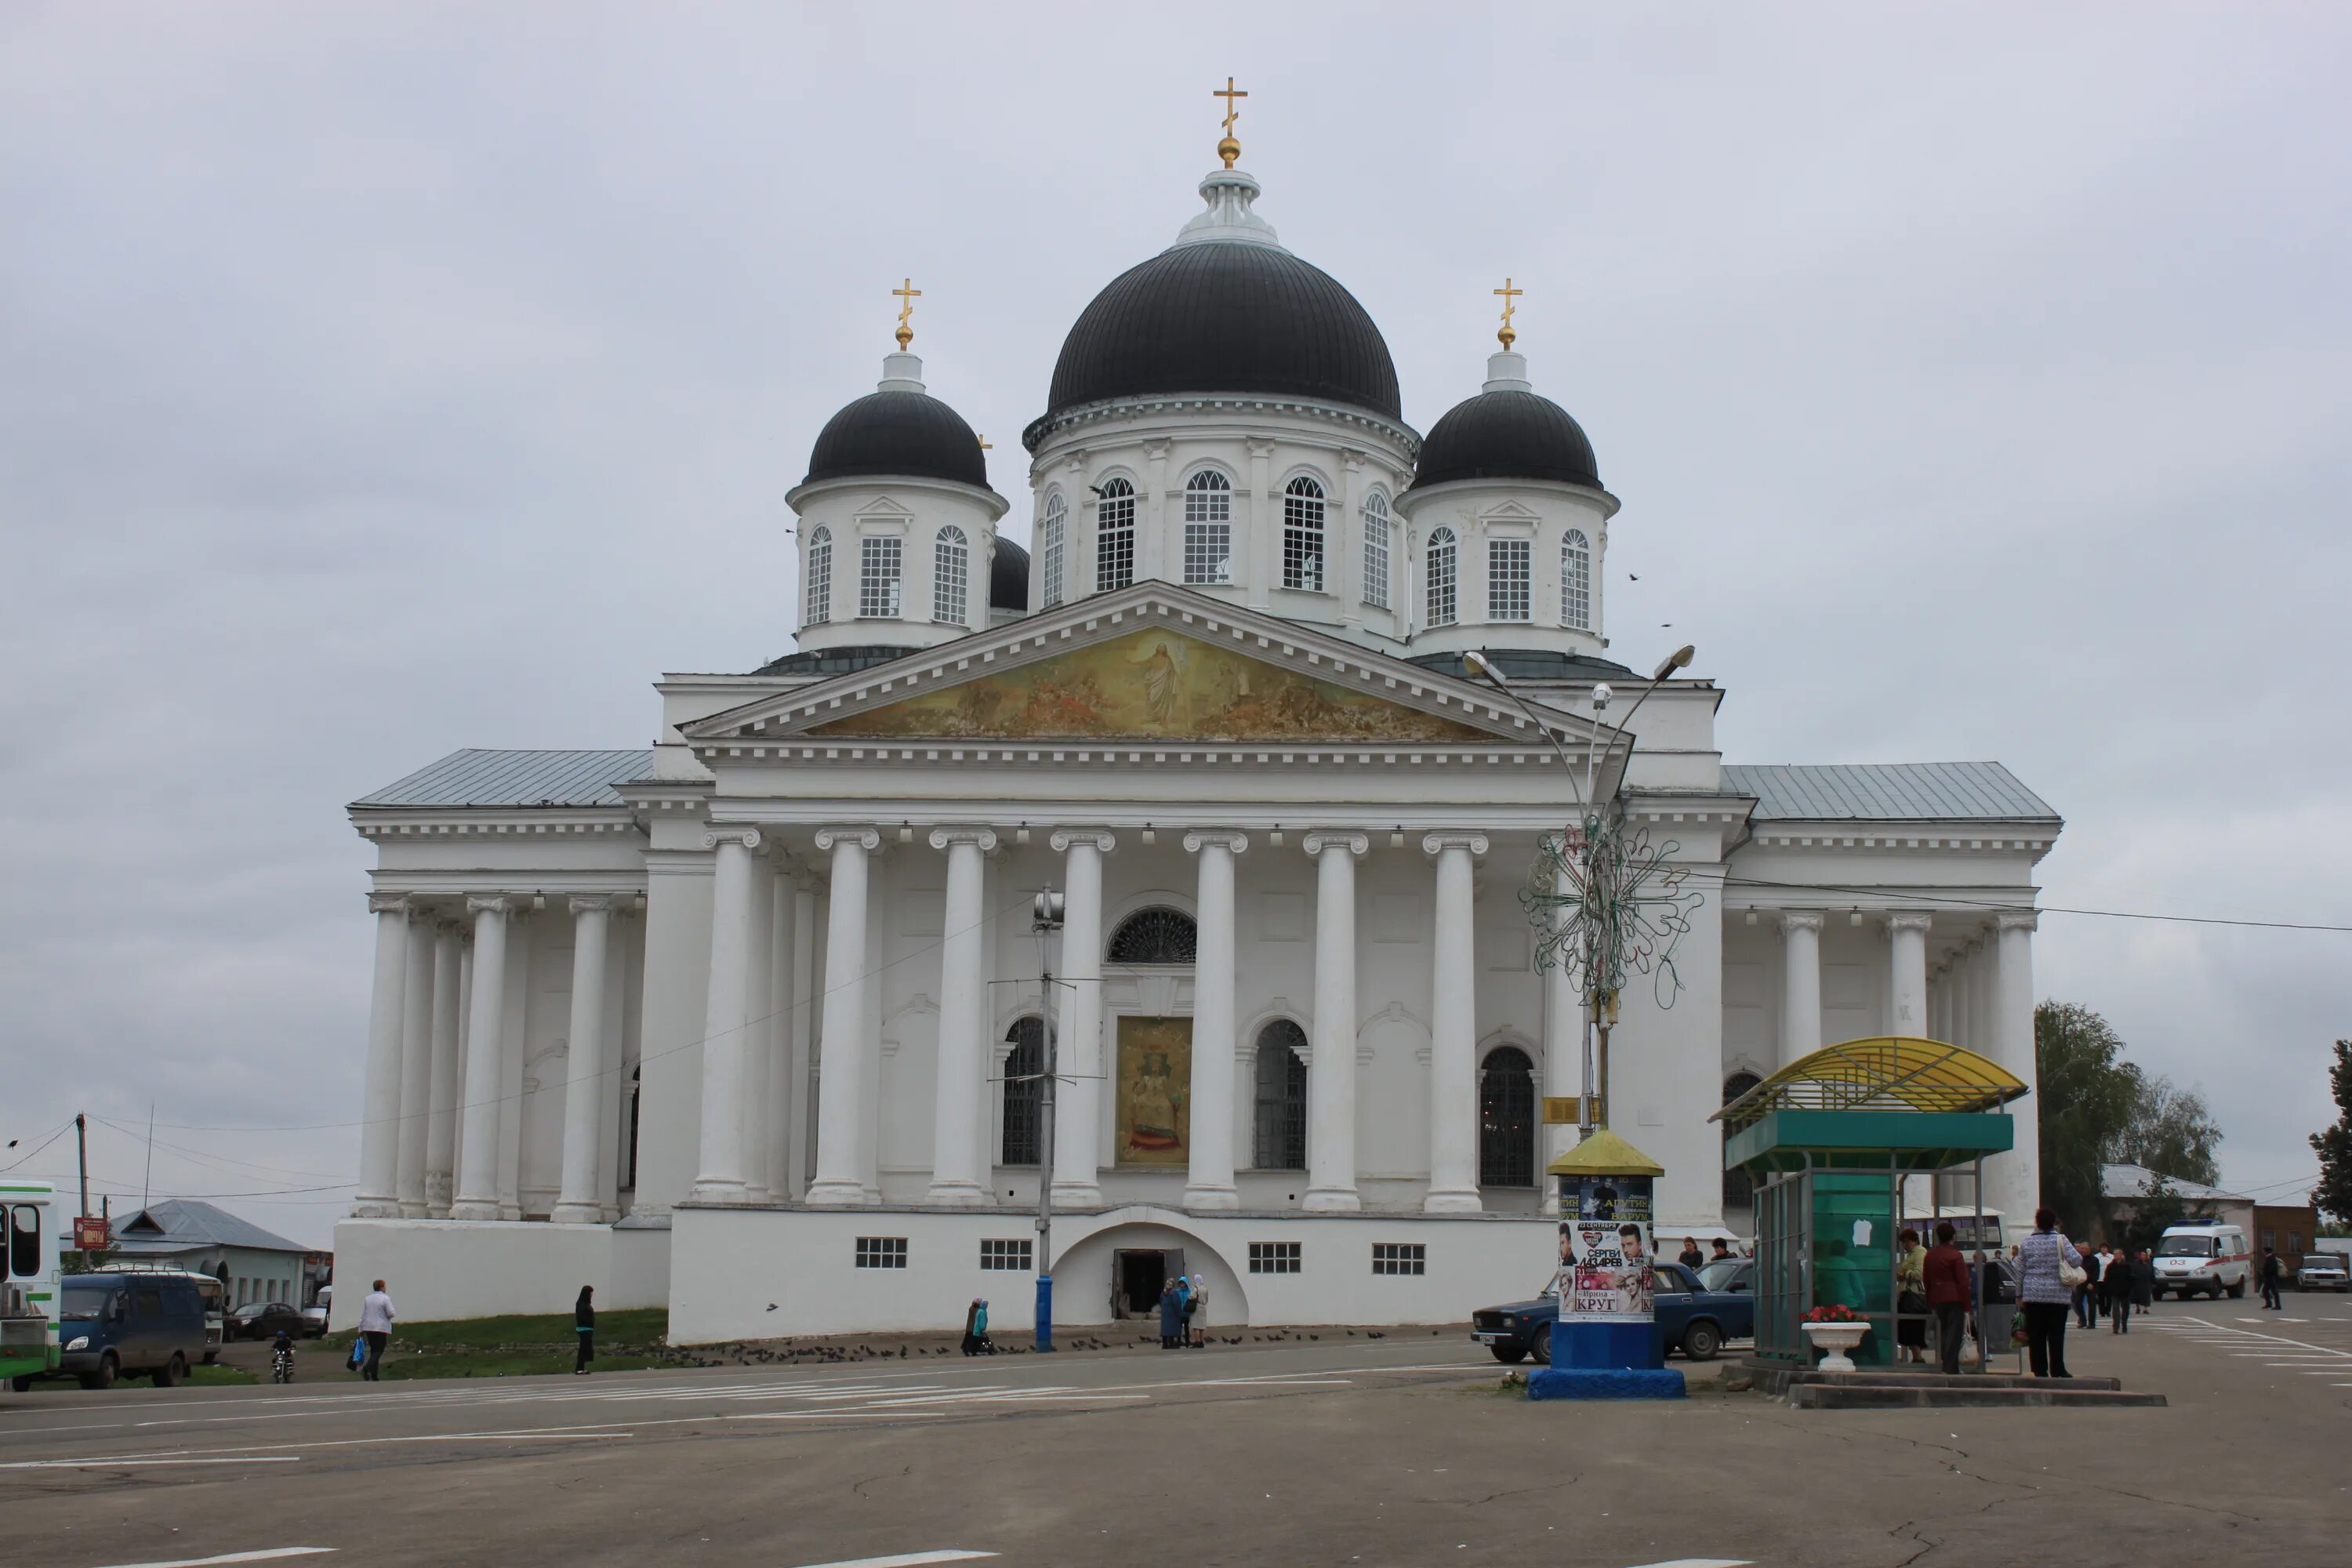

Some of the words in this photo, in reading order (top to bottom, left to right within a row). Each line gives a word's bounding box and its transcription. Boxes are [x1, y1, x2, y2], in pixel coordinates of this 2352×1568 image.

[1588, 1248, 1620, 1258] СЕРГЕЙ
[1580, 1258, 1622, 1267] ЛАЗАРЕВ
[1577, 1268, 1585, 1276] 21
[1583, 1290, 1608, 1298] Ирина
[1577, 1298, 1616, 1310] КРУГ
